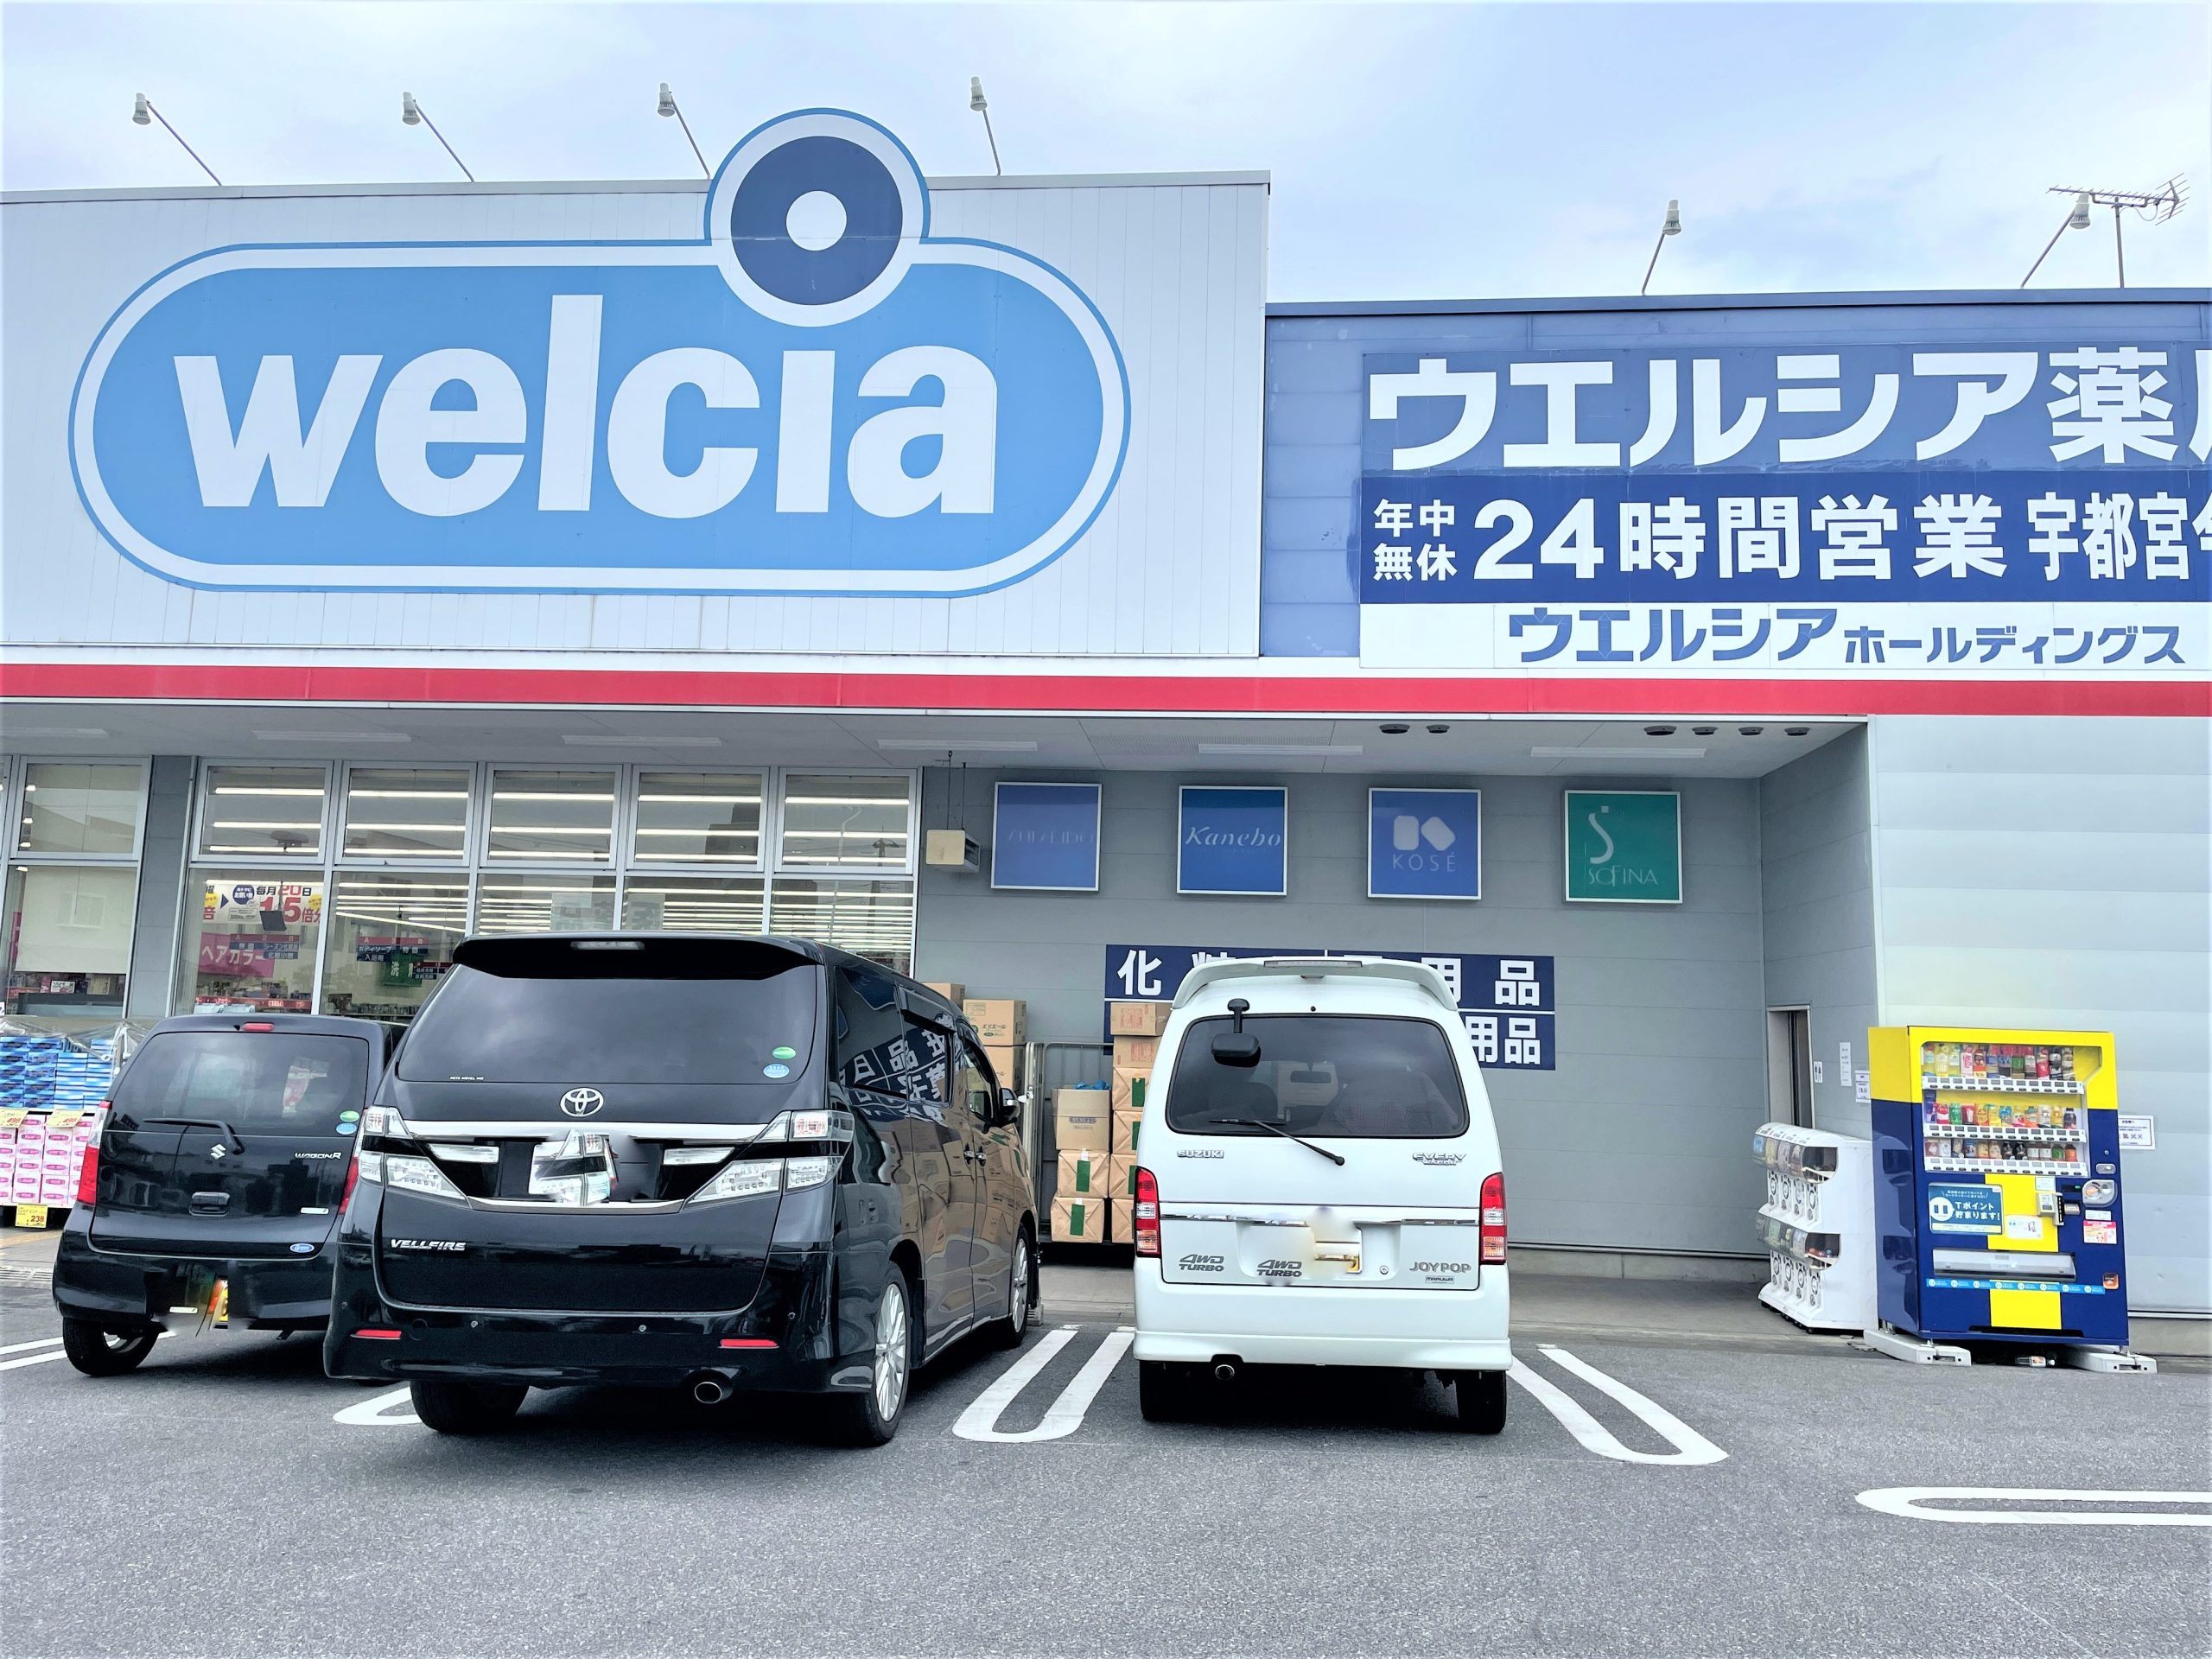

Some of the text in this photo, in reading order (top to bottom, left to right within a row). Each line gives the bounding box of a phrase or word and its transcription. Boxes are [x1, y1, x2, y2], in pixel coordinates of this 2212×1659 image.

[173, 294, 998, 519] welcia
[1372, 498, 1456, 538] 年中
[1472, 493, 2010, 582] 24時間営業
[1372, 543, 1458, 582] 無休
[1185, 825, 1281, 847] Kanebo
[1392, 851, 1457, 873] KOSÉ
[201, 944, 265, 966] ヘアカラー
[1177, 1150, 1224, 1159] SUZUKI
[1412, 1153, 1467, 1161] EVERY
[1955, 1201, 1994, 1211] Tポイント
[391, 1239, 467, 1251] VELLFIRE
[1179, 1254, 1224, 1263] 4WD
[1257, 1259, 1303, 1269] 4WD
[1179, 1263, 1224, 1272] TURBO
